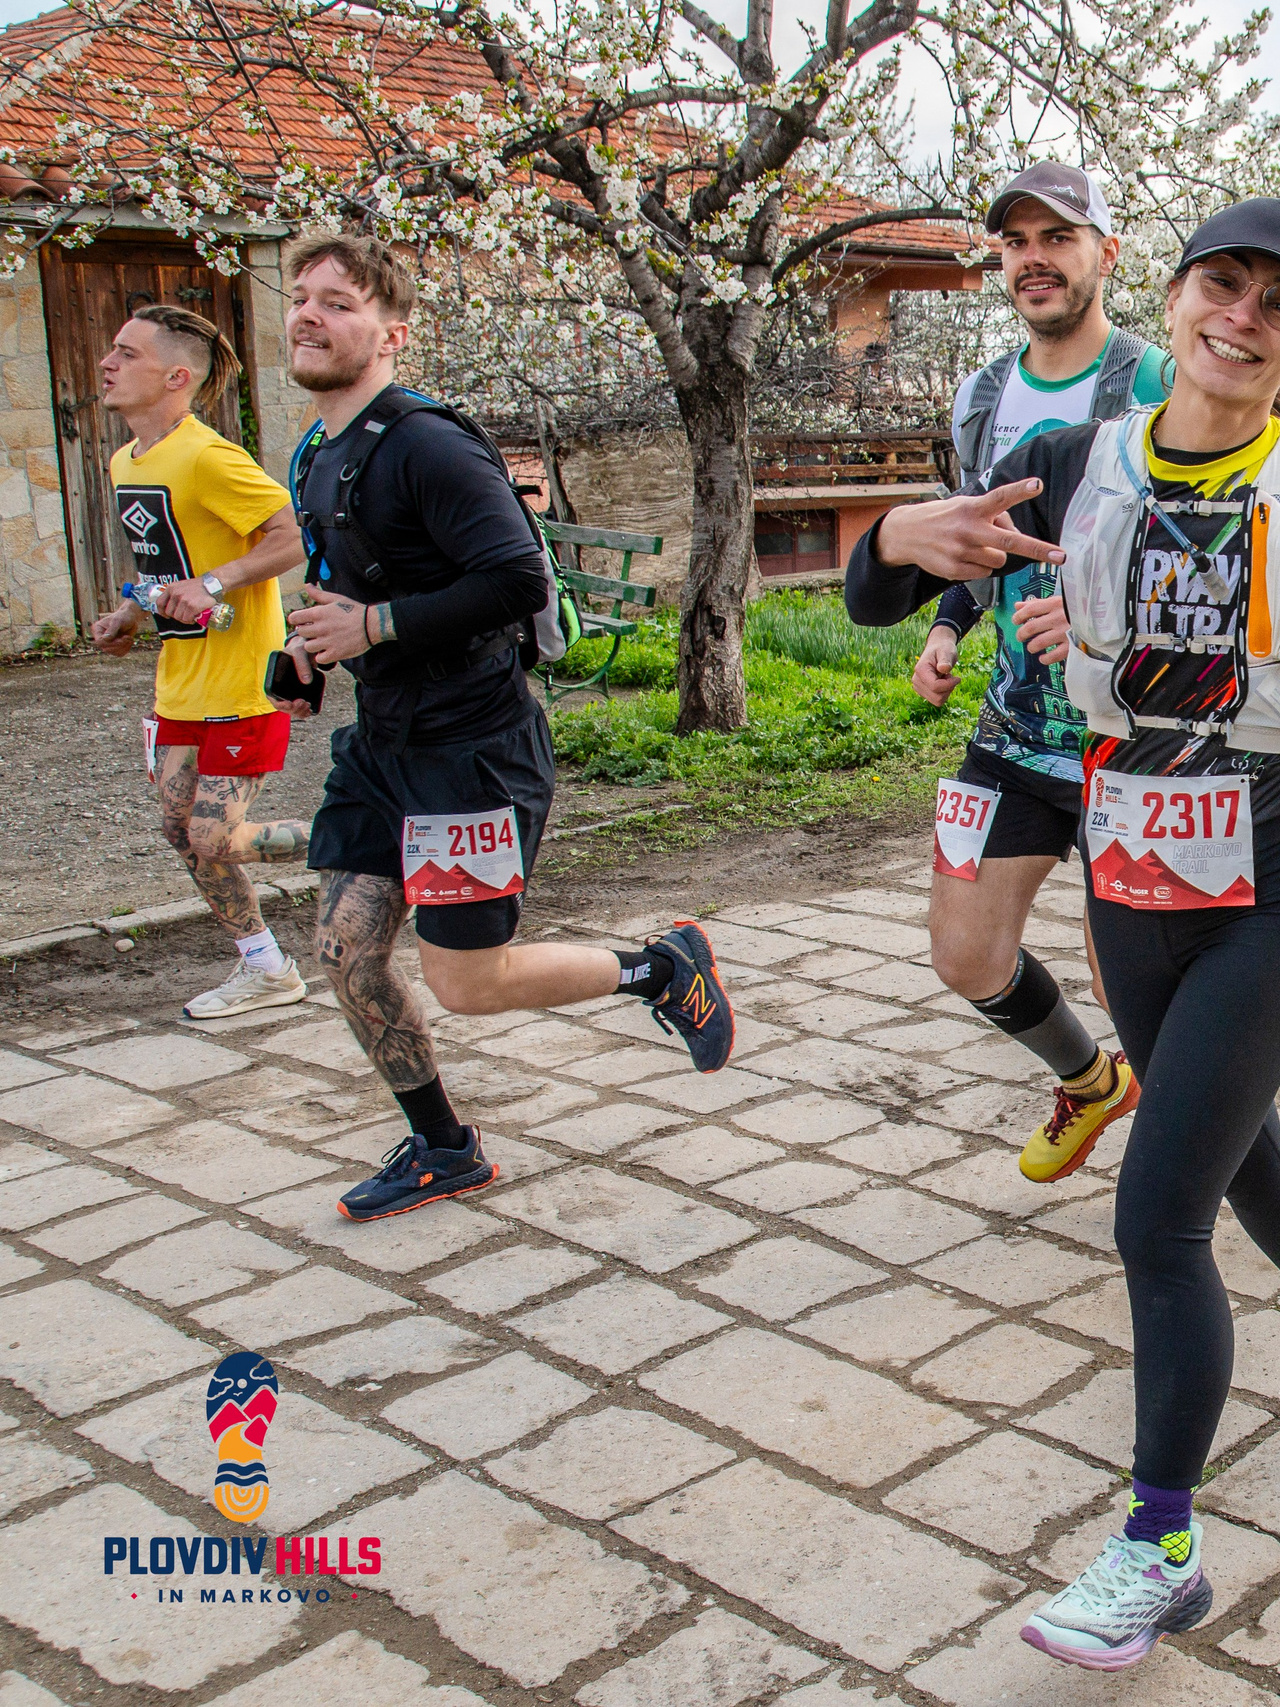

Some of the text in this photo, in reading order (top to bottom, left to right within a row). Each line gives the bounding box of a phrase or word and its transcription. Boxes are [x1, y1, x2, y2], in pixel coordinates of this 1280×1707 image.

[992, 424, 1020, 433] ience
[936, 789, 991, 831] 2351
[1142, 789, 1241, 840] 2317
[1092, 811, 1109, 828] 22K
[447, 818, 514, 857] 2194
[406, 844, 421, 854] 22K
[1173, 842, 1242, 860] MARKOVO
[1172, 860, 1210, 875] TRAIL
